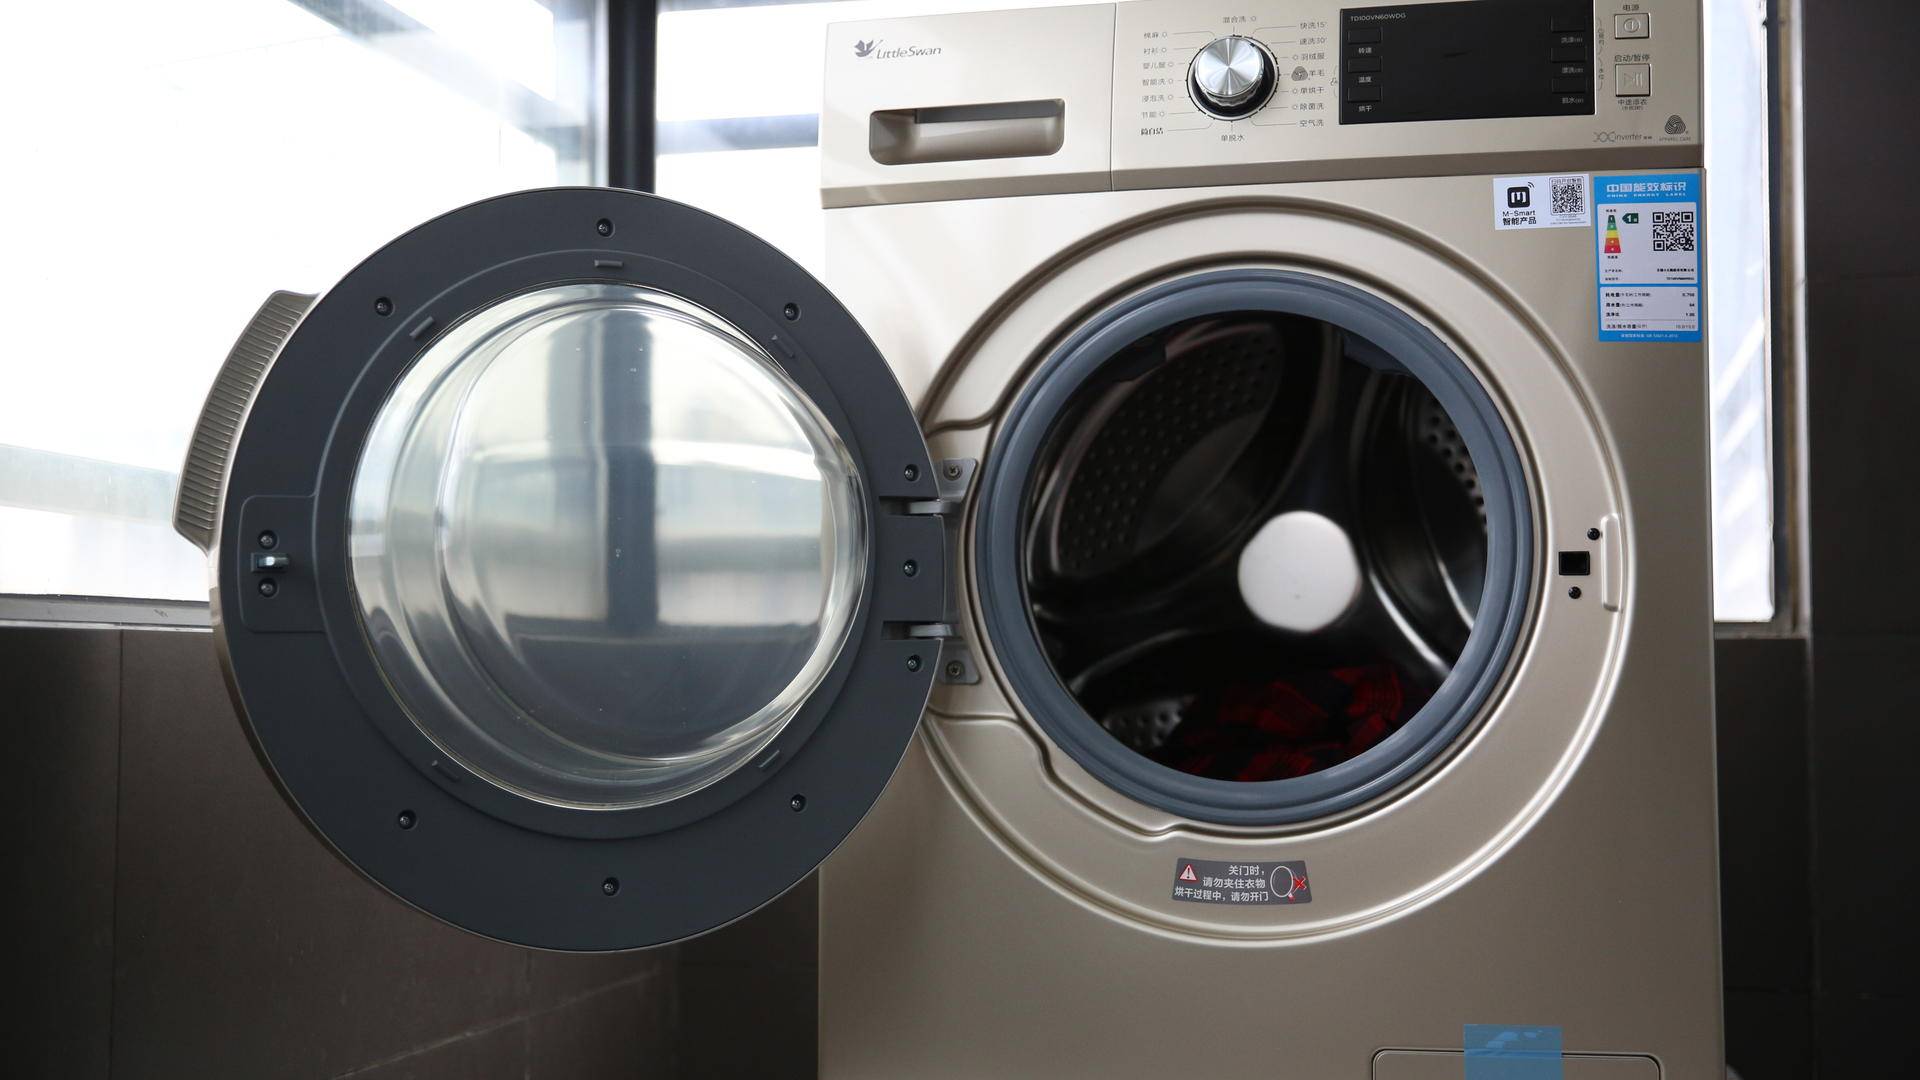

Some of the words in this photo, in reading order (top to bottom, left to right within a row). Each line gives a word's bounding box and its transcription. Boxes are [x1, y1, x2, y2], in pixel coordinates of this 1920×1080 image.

[1350, 13, 1406, 22] TD100VN60WDG
[877, 45, 942, 60] LittleSwan
[1614, 54, 1650, 63] 启动/暂停
[1300, 119, 1324, 127] 空气洗
[1606, 181, 1687, 193] 中国能效标识
[1502, 210, 1536, 218] M-Smart
[1502, 217, 1537, 226] 智能产品
[1202, 876, 1266, 889] 请勿夹住衣物
